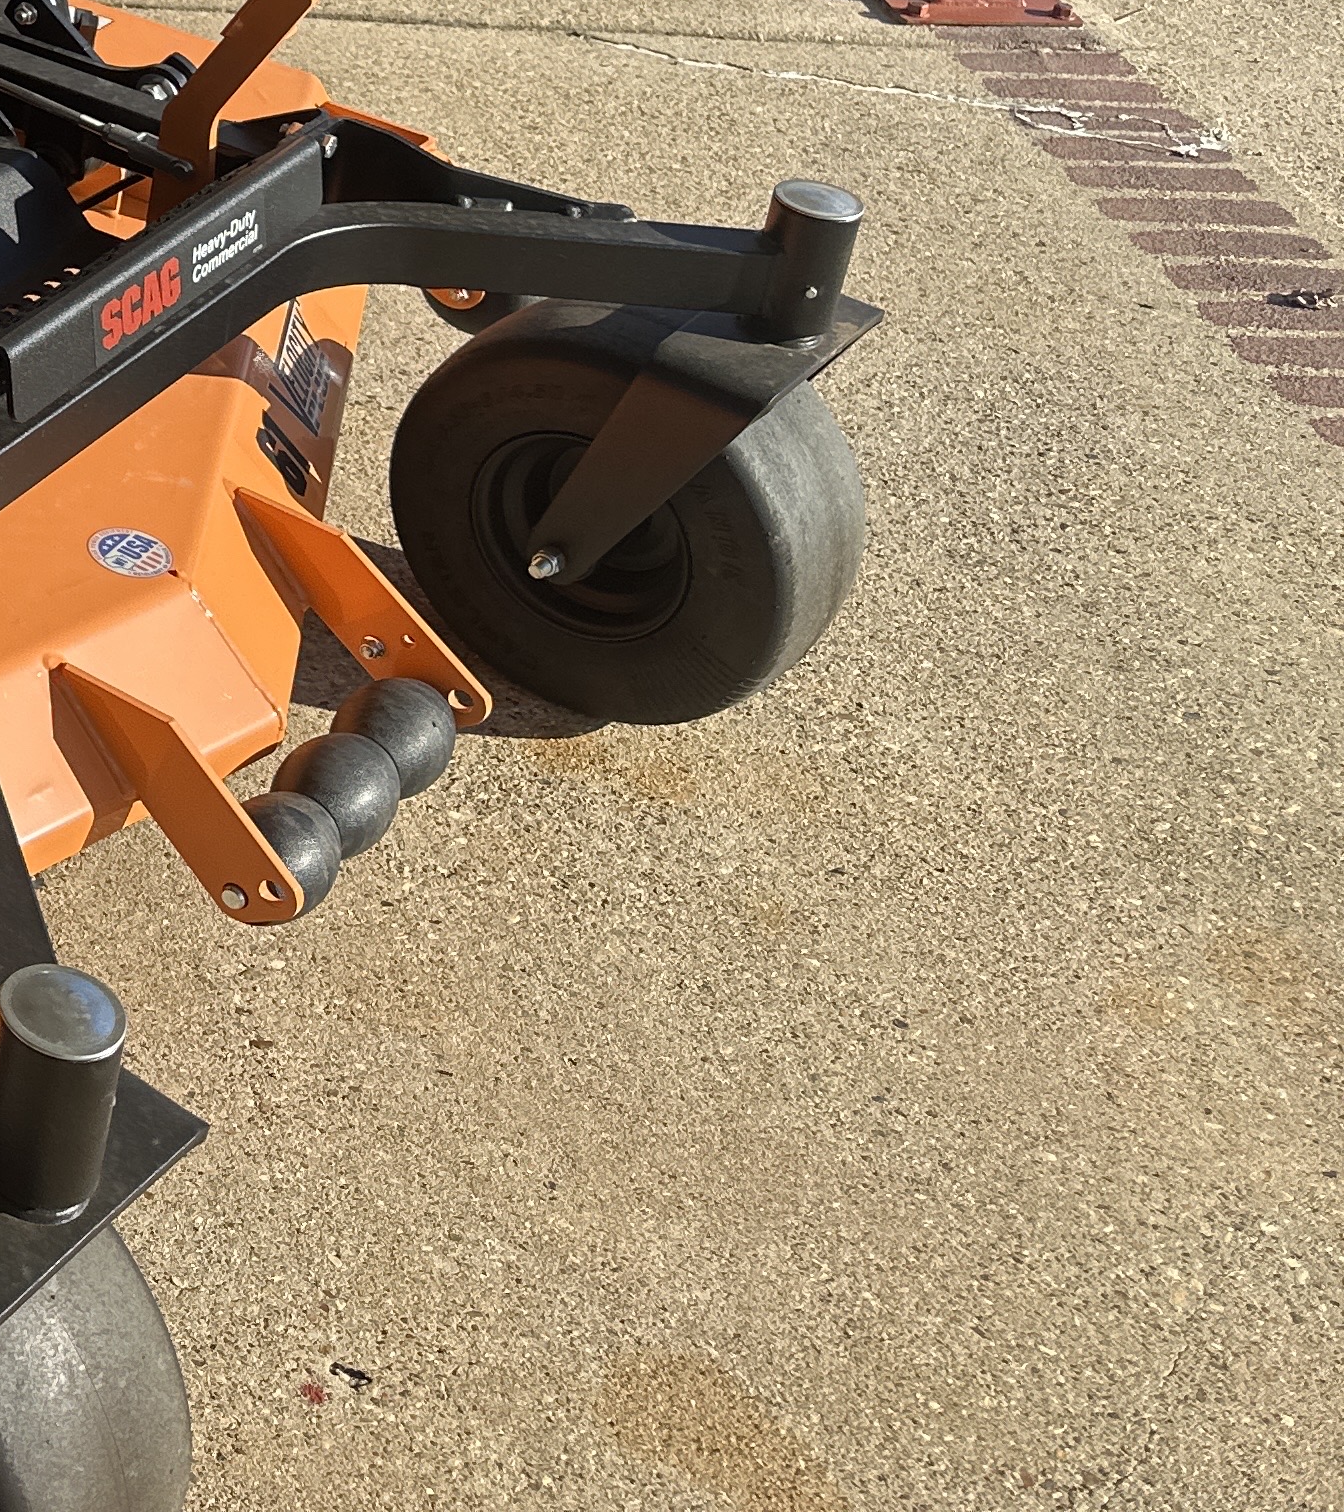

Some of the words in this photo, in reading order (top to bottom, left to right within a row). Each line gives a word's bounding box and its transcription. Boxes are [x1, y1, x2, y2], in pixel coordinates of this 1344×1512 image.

[192, 210, 256, 264] Heavy-Duty
[192, 224, 258, 283] Commercial
[101, 256, 181, 350] SCAG
[268, 307, 320, 437] VELOCITY
[116, 534, 158, 560] USA
